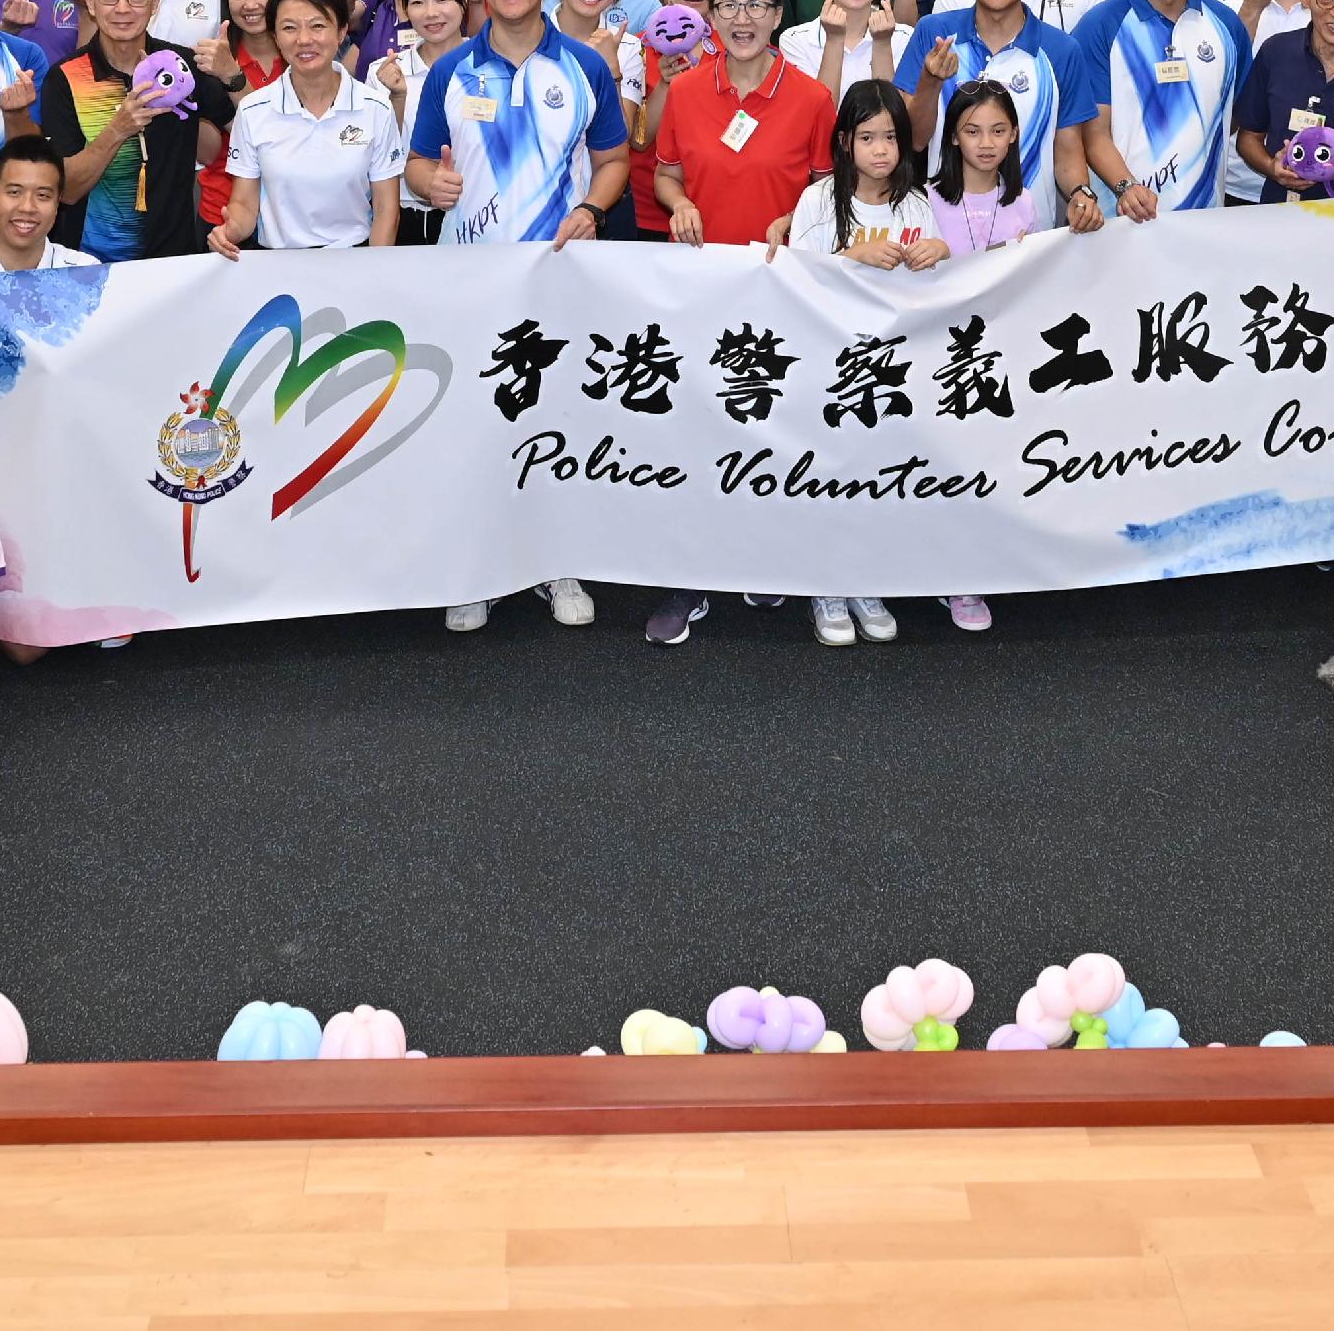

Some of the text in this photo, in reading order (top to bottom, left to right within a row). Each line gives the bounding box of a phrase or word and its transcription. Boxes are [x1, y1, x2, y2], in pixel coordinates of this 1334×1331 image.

[456, 192, 499, 245] HKPF
[512, 430, 688, 491] Police
[715, 447, 998, 501] Volunteer
[1021, 427, 1243, 499] Services
